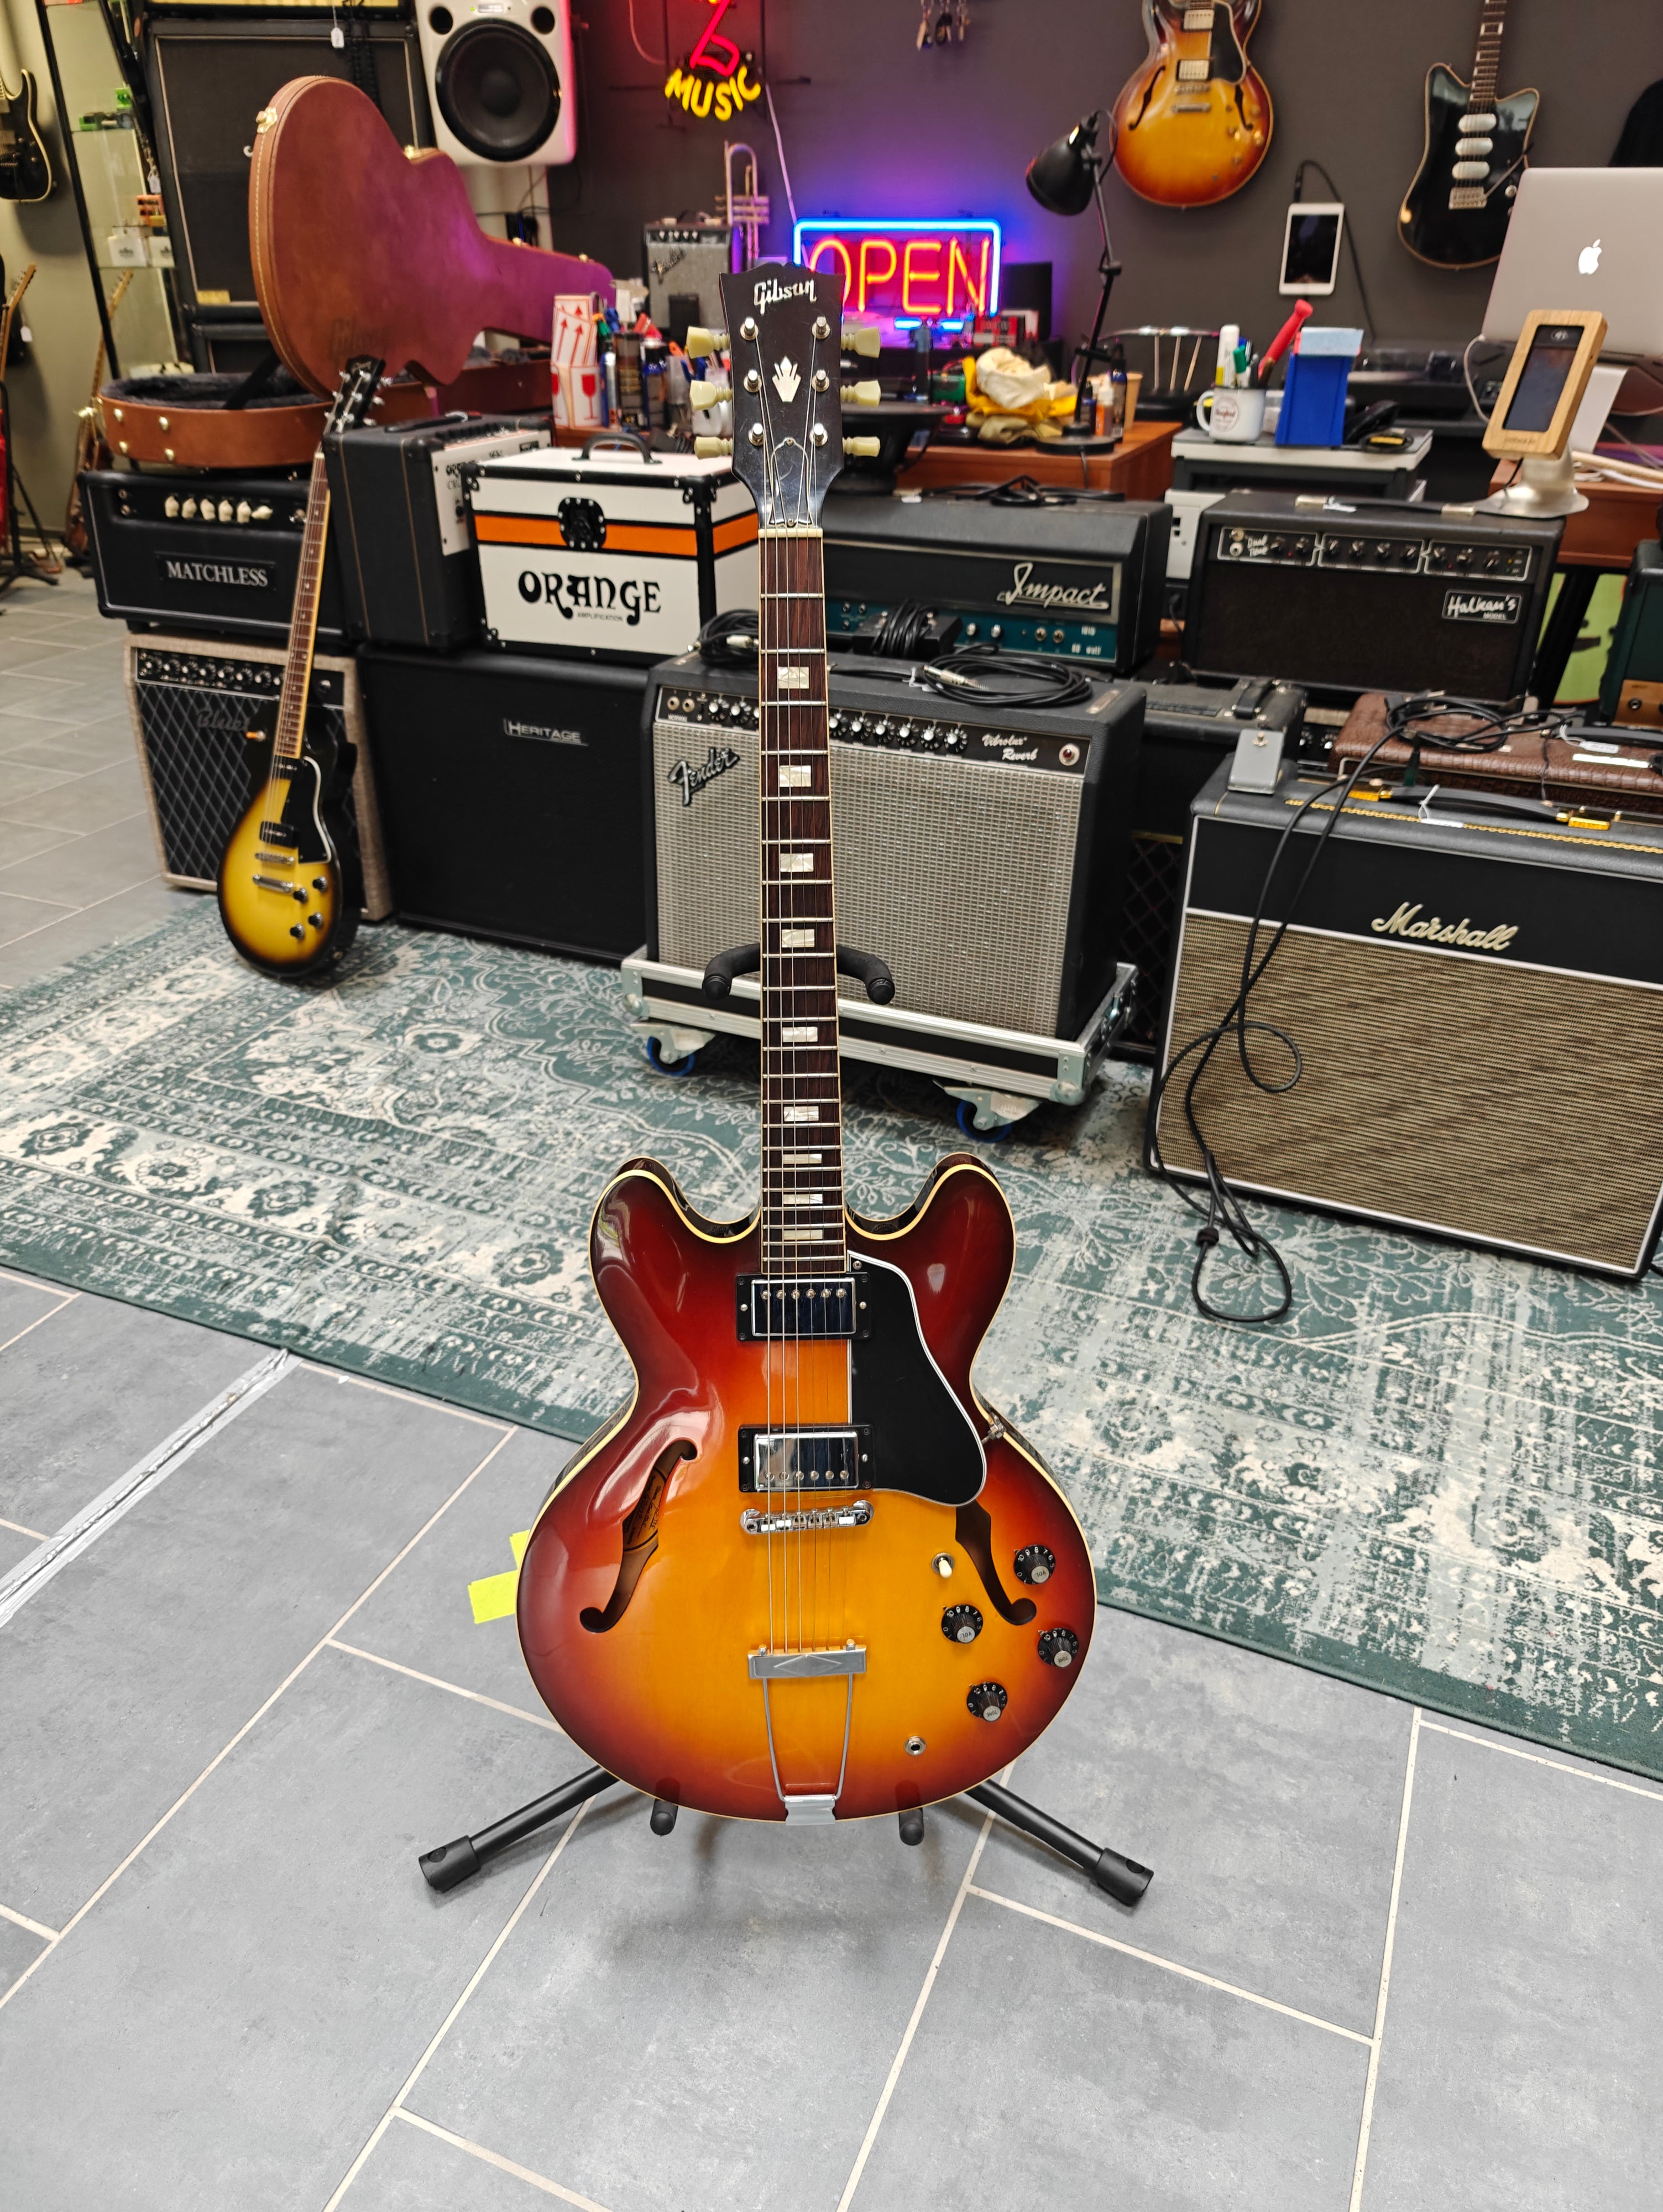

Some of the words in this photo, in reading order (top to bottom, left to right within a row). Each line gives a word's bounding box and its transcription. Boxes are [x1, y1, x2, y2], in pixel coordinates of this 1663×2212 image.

[665, 65, 761, 121] MUSIC
[754, 278, 817, 315] Gibson
[809, 236, 990, 317] OPEN
[166, 561, 268, 587] MATCHLESS
[997, 562, 1108, 609] Impact
[519, 571, 661, 626] ORANGE
[578, 612, 623, 621] AMPLIFICATION
[508, 721, 581, 742] HERITAGE
[1002, 748, 1039, 761] Reverb
[667, 747, 739, 806] Fender
[1371, 902, 1517, 951] Marshall
